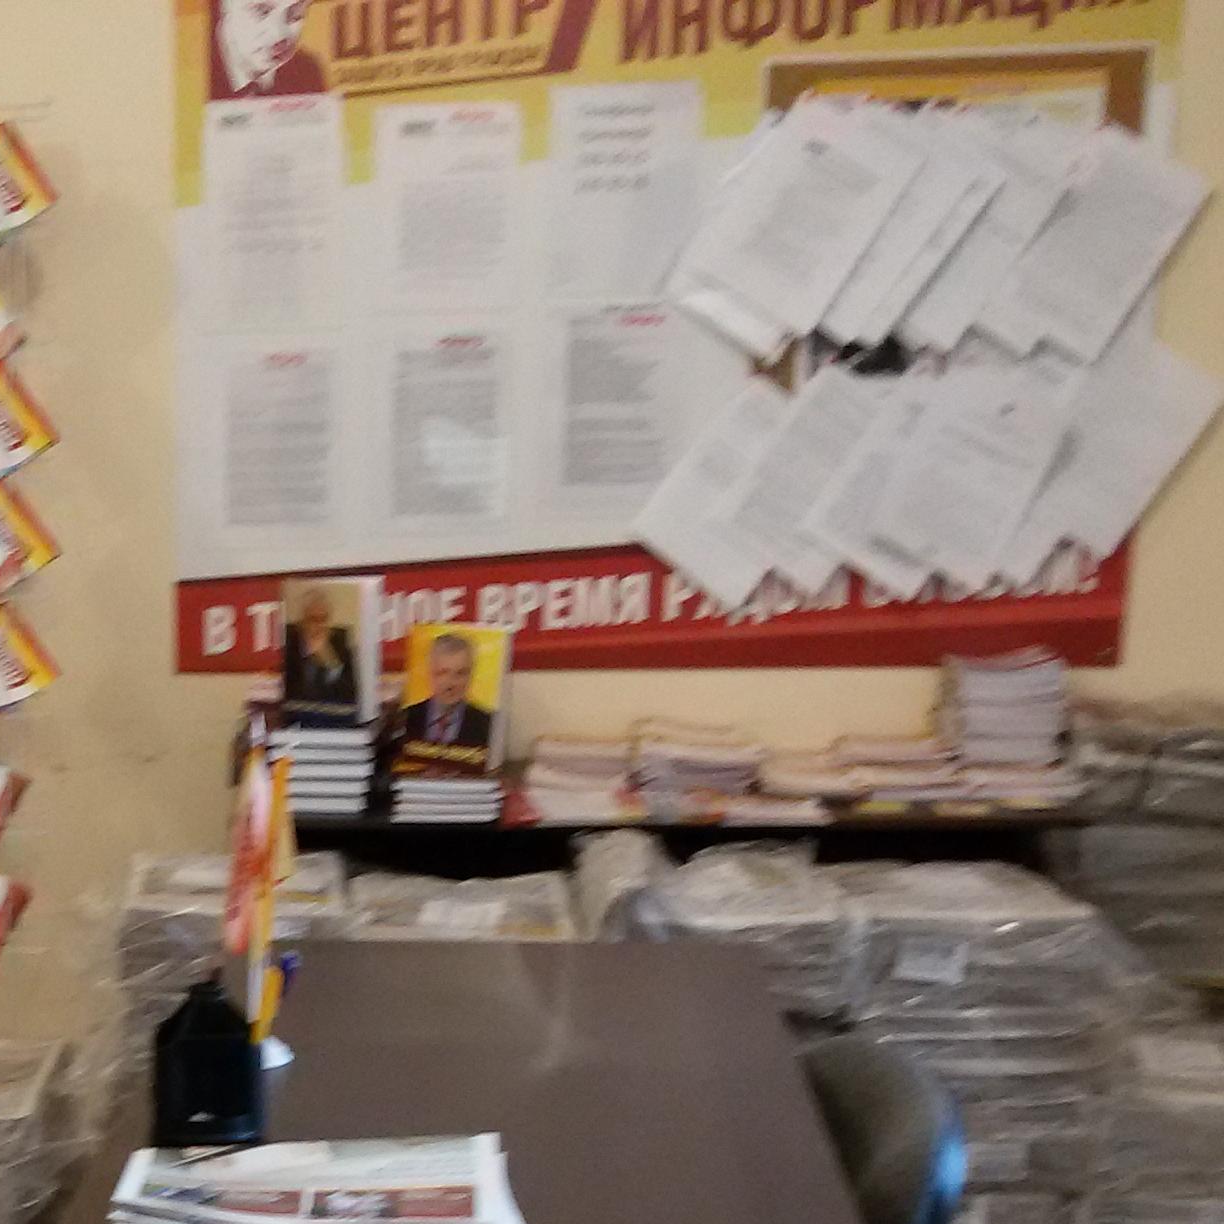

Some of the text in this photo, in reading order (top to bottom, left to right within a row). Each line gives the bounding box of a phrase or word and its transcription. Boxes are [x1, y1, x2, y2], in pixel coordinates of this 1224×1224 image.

[202, 604, 237, 656] В
[247, 585, 468, 652] ТНОЕ
[476, 571, 653, 632] ВРЕМЯ
